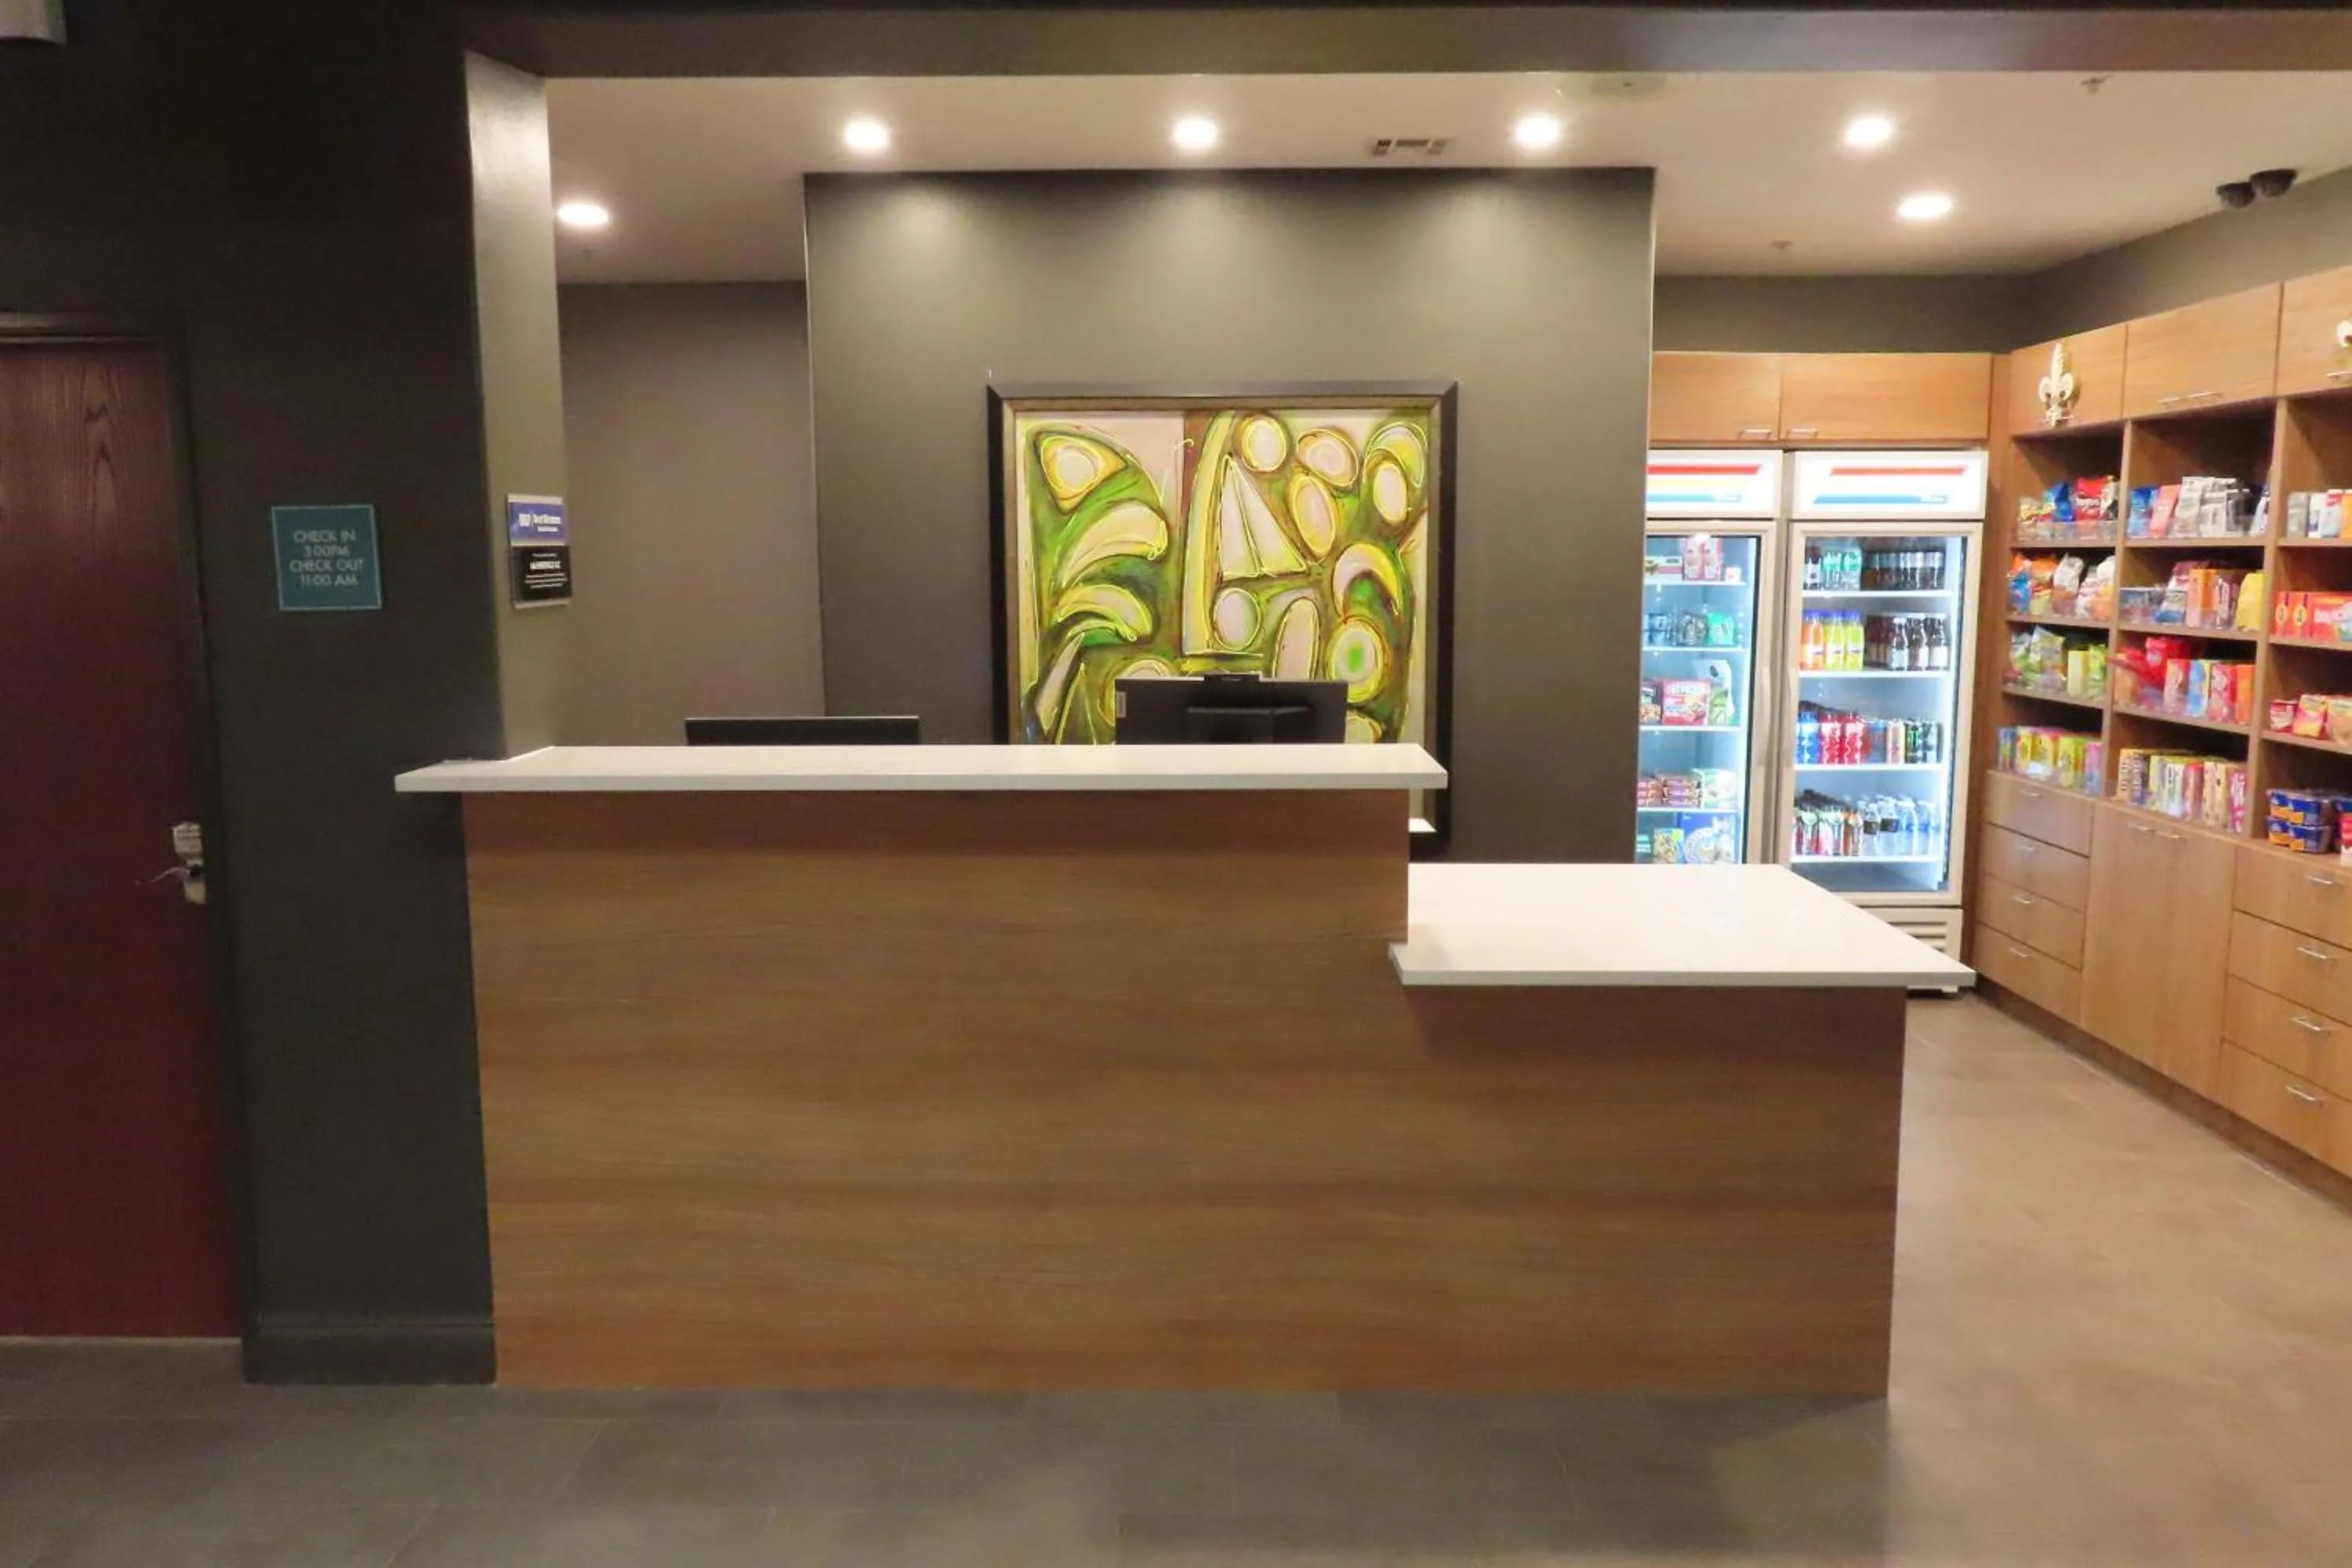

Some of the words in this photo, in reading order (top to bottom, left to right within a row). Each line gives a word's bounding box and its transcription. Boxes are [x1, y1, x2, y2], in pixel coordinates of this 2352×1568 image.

[293, 529, 337, 543] CHECK
[341, 529, 356, 542] IN
[289, 559, 333, 572] CHECK
[336, 558, 364, 572] OUT
[334, 573, 358, 586] AM
